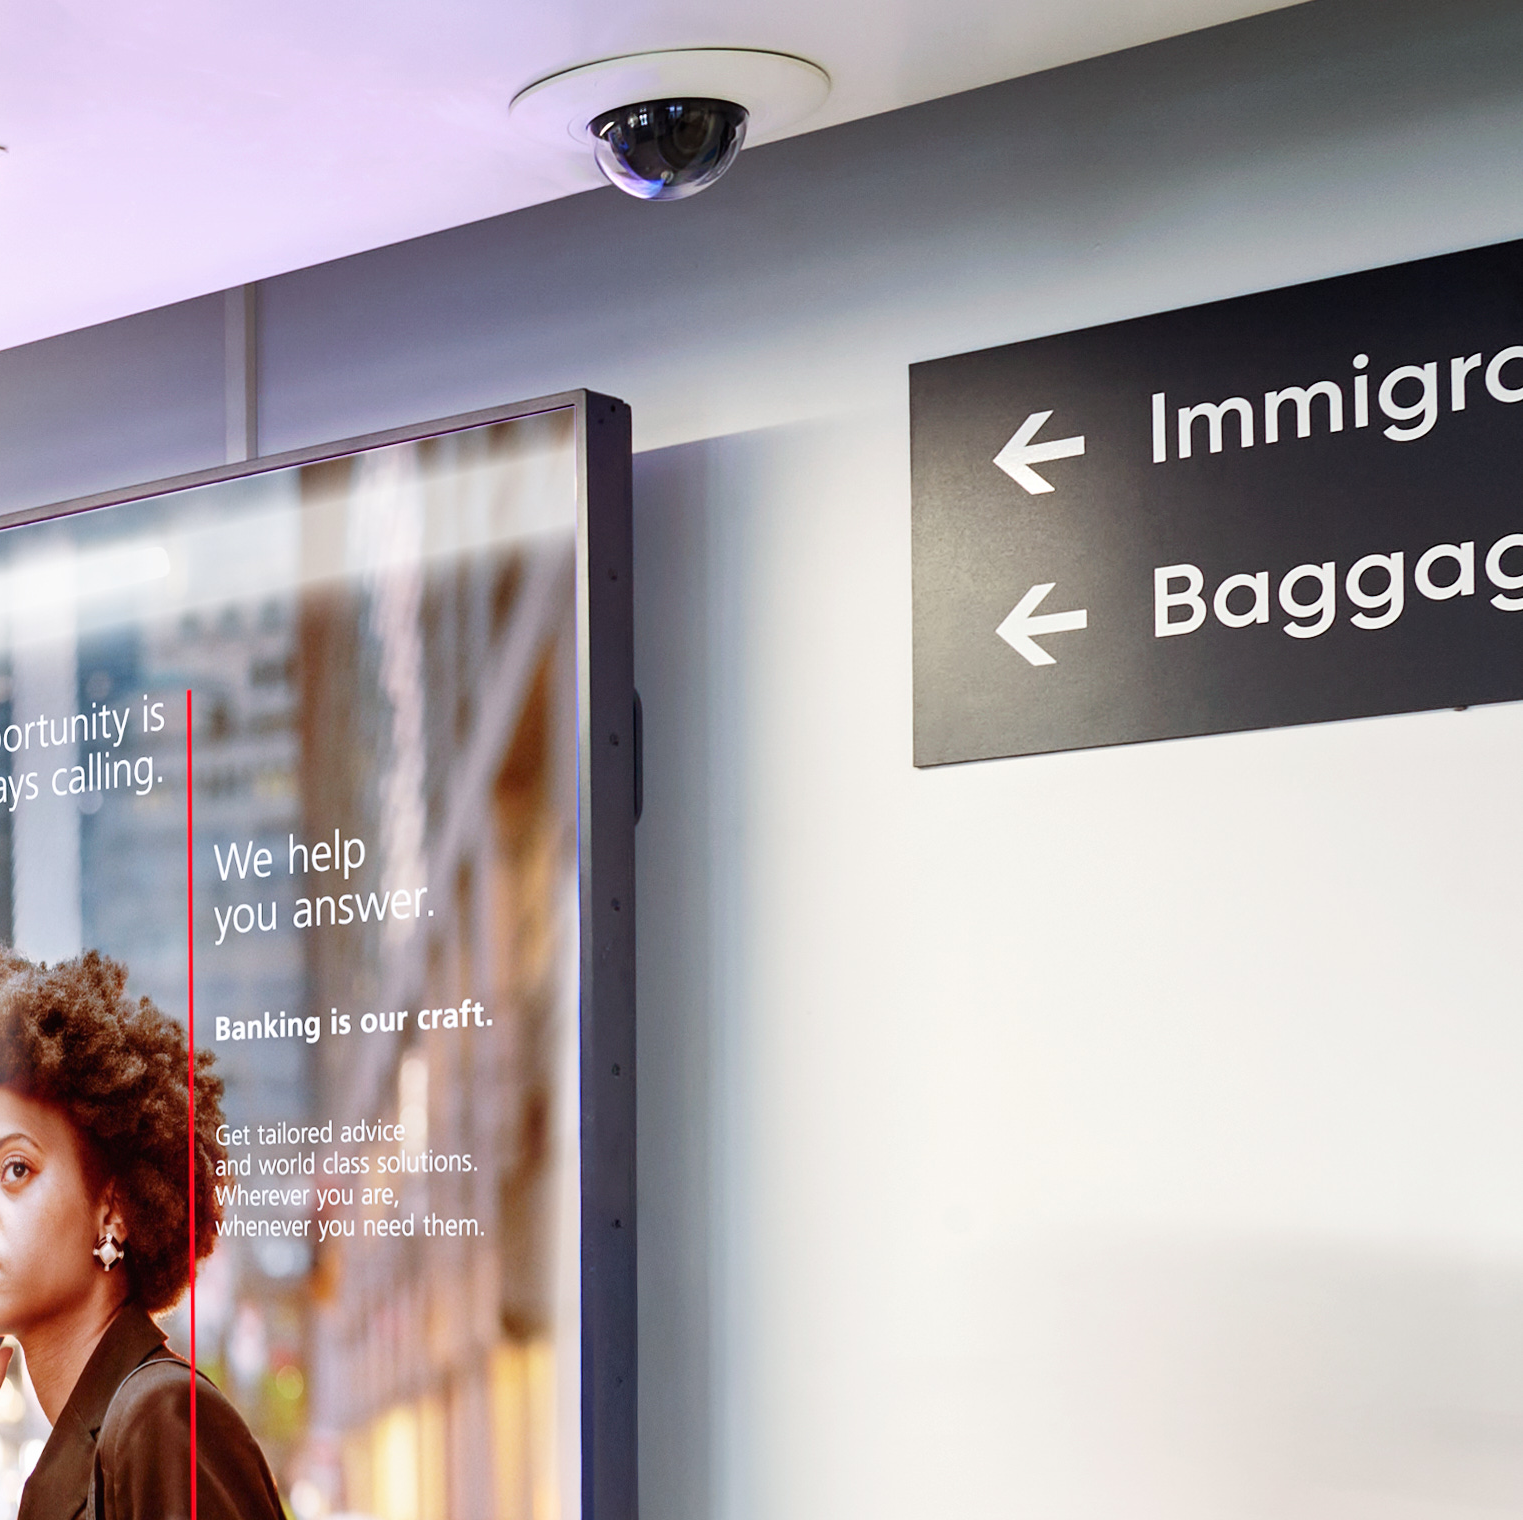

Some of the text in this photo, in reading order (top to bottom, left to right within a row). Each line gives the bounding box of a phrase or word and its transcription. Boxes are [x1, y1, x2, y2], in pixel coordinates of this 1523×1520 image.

[143, 694, 165, 732] is
[52, 752, 163, 796] calling.
[214, 828, 365, 881] We help
[214, 887, 434, 945] you answer.
[215, 999, 493, 1043] Banking is our craft.
[215, 1119, 406, 1146] Get tailored advice
[215, 1149, 478, 1177] and world class solutions.
[215, 1185, 399, 1212] Wherever you are,
[215, 1213, 485, 1242] whenever you need them.
